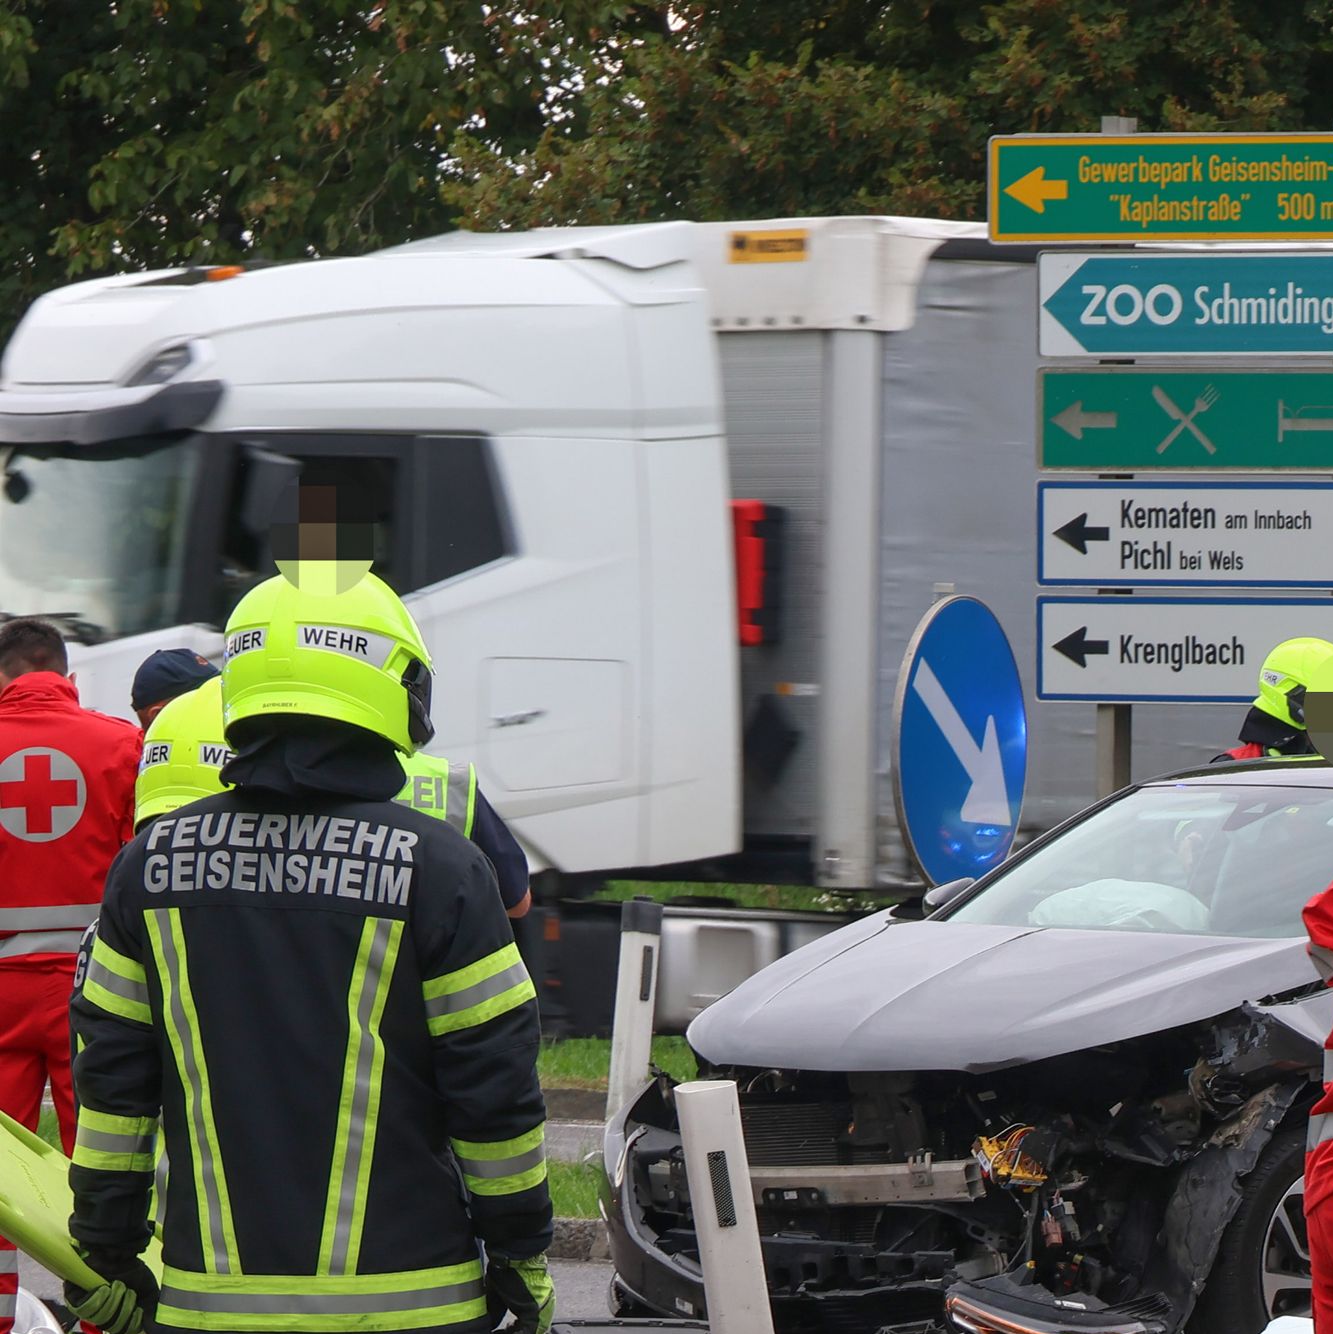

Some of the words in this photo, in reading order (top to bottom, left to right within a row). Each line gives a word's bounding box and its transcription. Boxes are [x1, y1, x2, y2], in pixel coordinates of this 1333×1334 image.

[1078, 155, 1203, 189] Gewerbepark
[1276, 193, 1315, 221] 500
[1080, 283, 1183, 326] ZOO
[1119, 499, 1216, 529] Kematen
[1225, 512, 1248, 529] am
[1253, 509, 1312, 530] Innbach
[1119, 540, 1172, 570] Pichl
[1180, 551, 1202, 570] bei
[1209, 550, 1244, 571] Wels
[303, 627, 368, 656] WEHR
[1119, 634, 1245, 672] Krenglbach
[146, 811, 420, 863] FEUERWEHR
[143, 850, 414, 906] GEISENSHEIM
